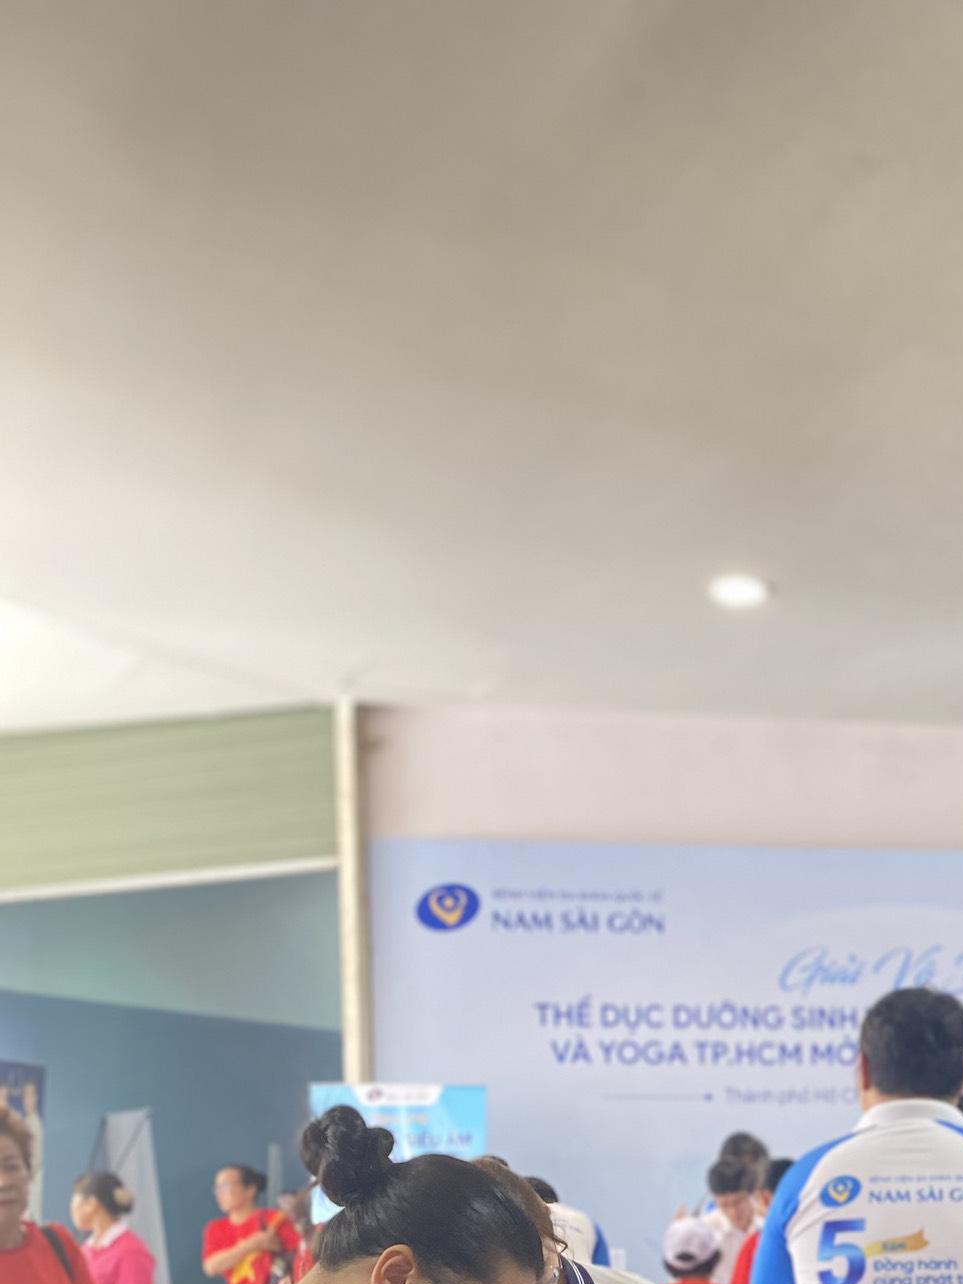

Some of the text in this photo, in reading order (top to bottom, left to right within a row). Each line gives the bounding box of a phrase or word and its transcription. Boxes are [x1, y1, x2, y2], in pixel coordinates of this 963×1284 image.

[491, 905, 666, 934] NAM SÀI GÒN
[600, 1003, 664, 1034] DỤC
[791, 1006, 858, 1030] SINH
[550, 1035, 593, 1065] VÀ
[598, 1040, 689, 1066] YOGA
[694, 1040, 802, 1067] TP.HCM
[868, 1189, 911, 1202] NAM
[917, 1185, 944, 1202] SÀI
[873, 1258, 958, 1274] Đồng hành
